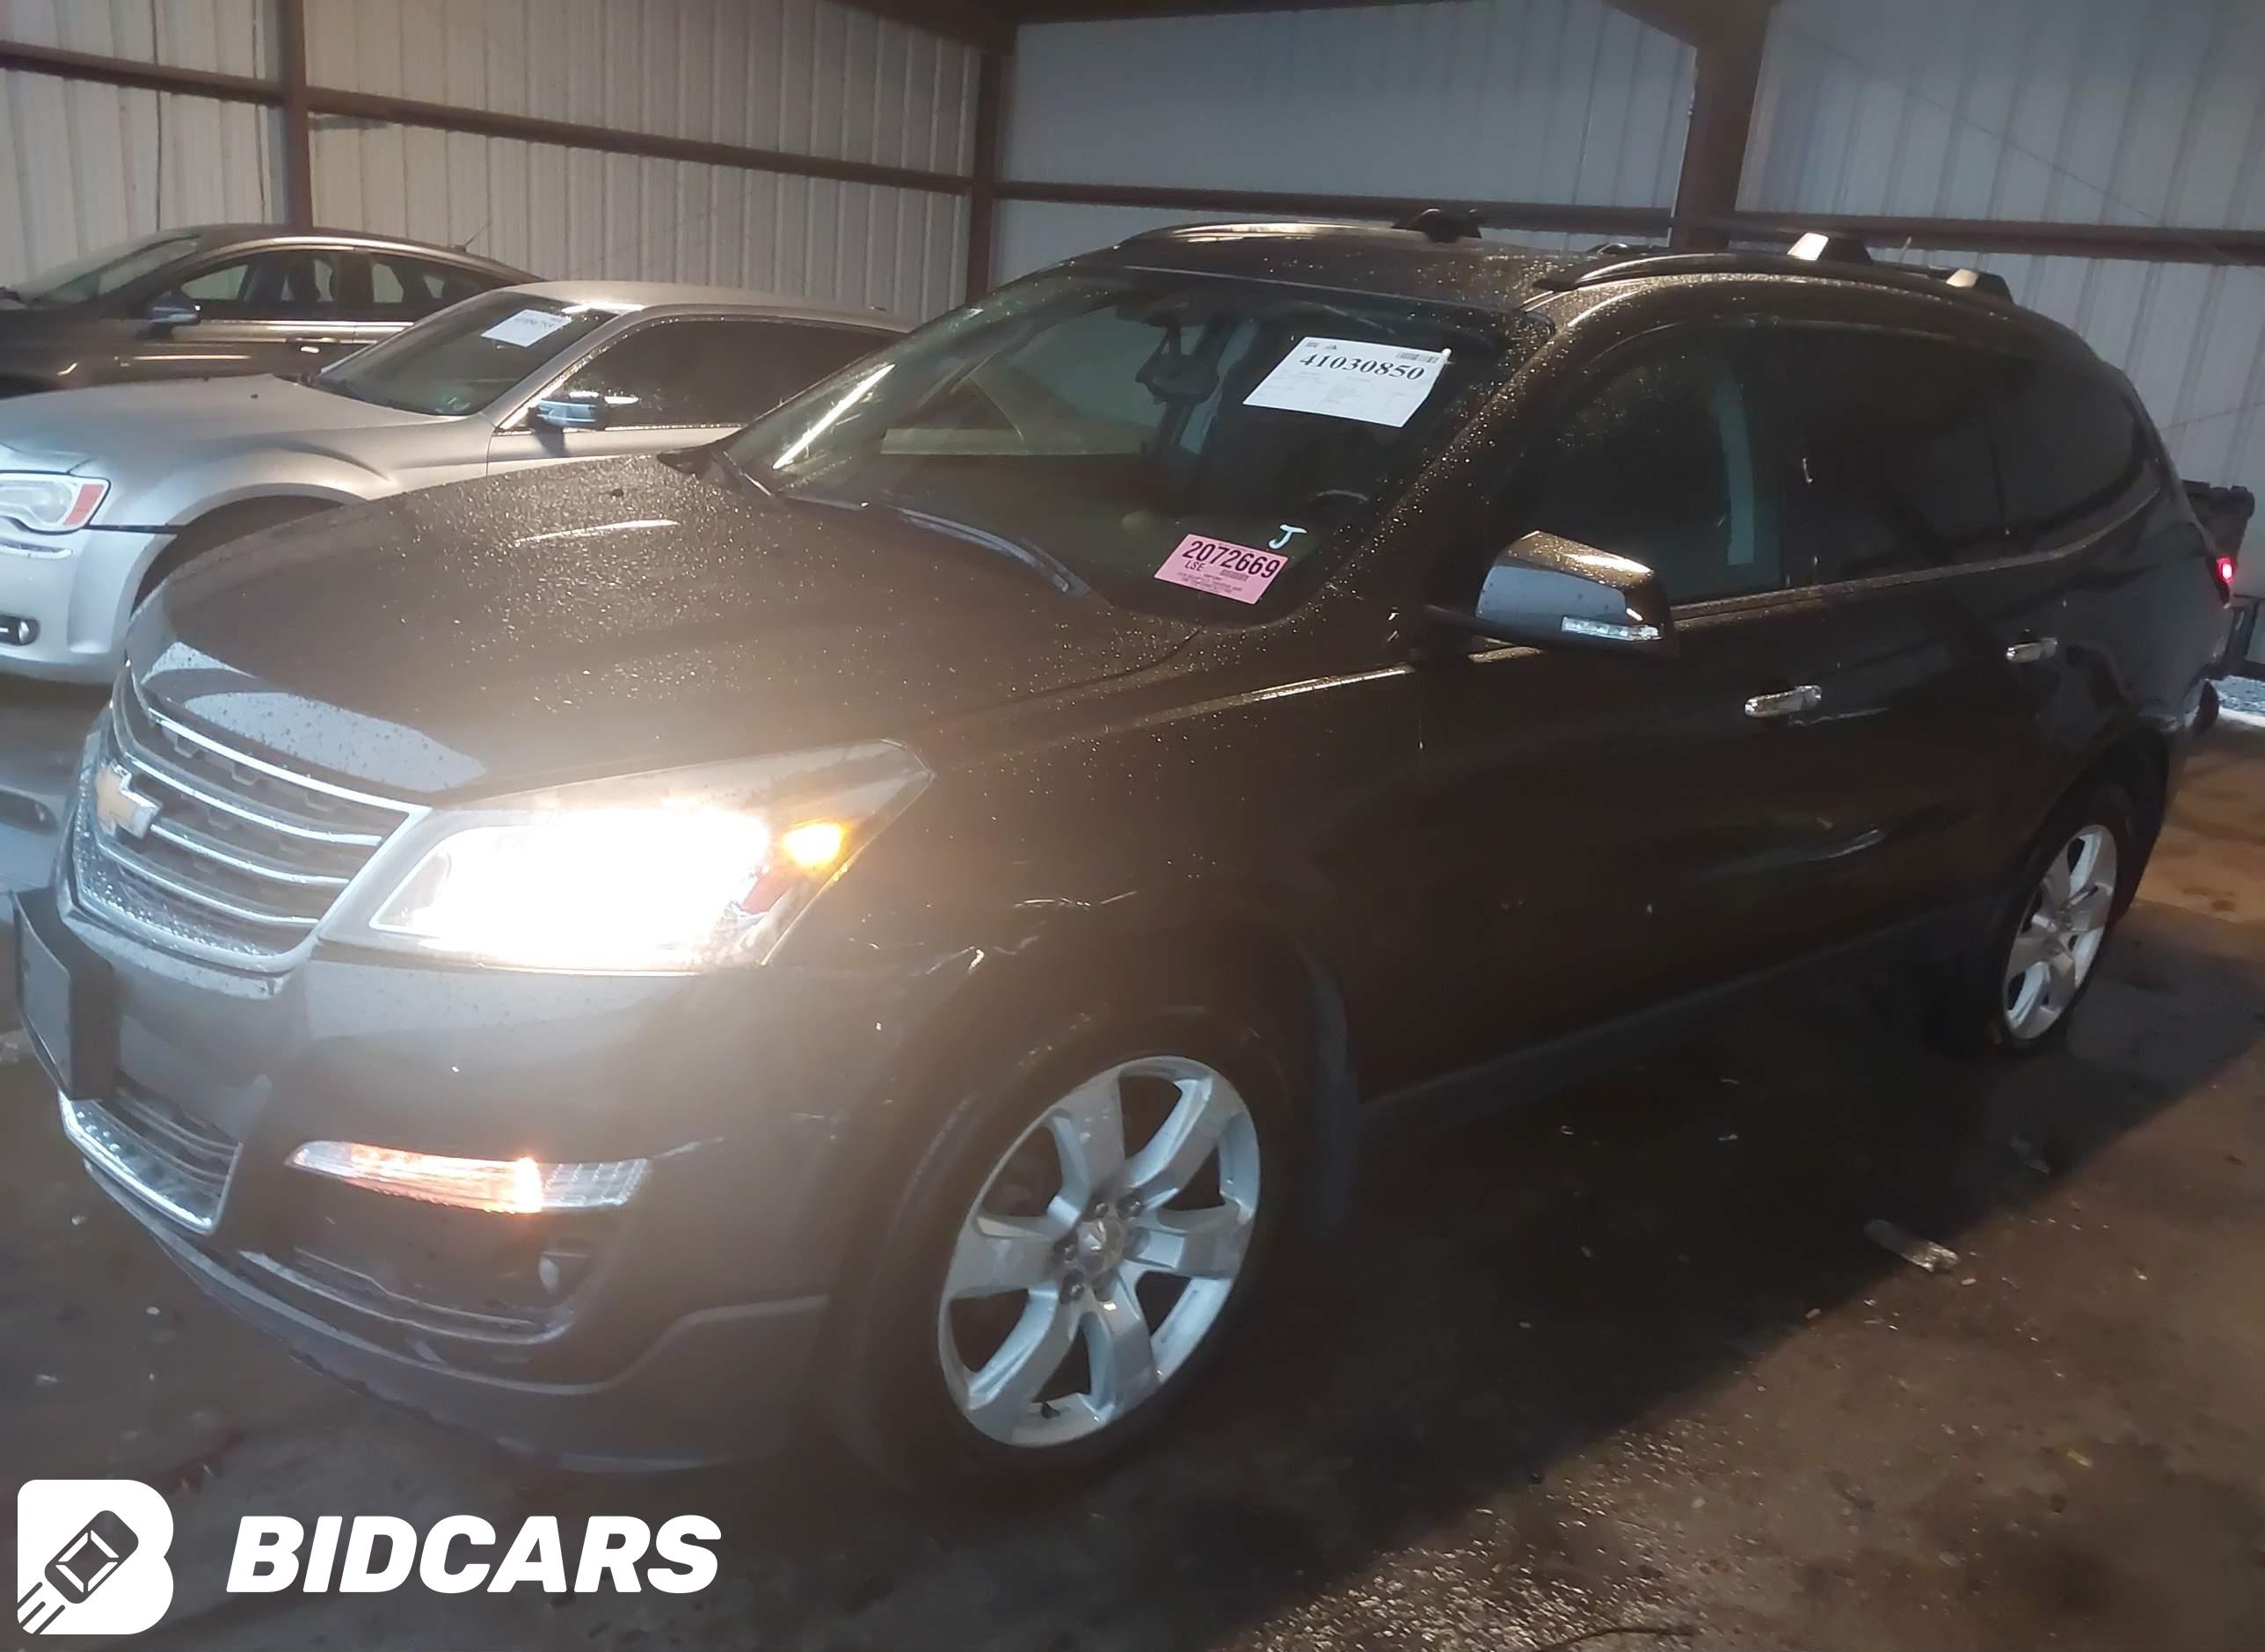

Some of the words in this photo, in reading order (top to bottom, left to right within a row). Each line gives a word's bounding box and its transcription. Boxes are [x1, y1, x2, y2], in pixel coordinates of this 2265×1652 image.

[1299, 353, 1426, 381] 41030850
[1268, 524, 1307, 549] J
[1182, 540, 1281, 579] 2072669
[1184, 560, 1206, 571] LSE
